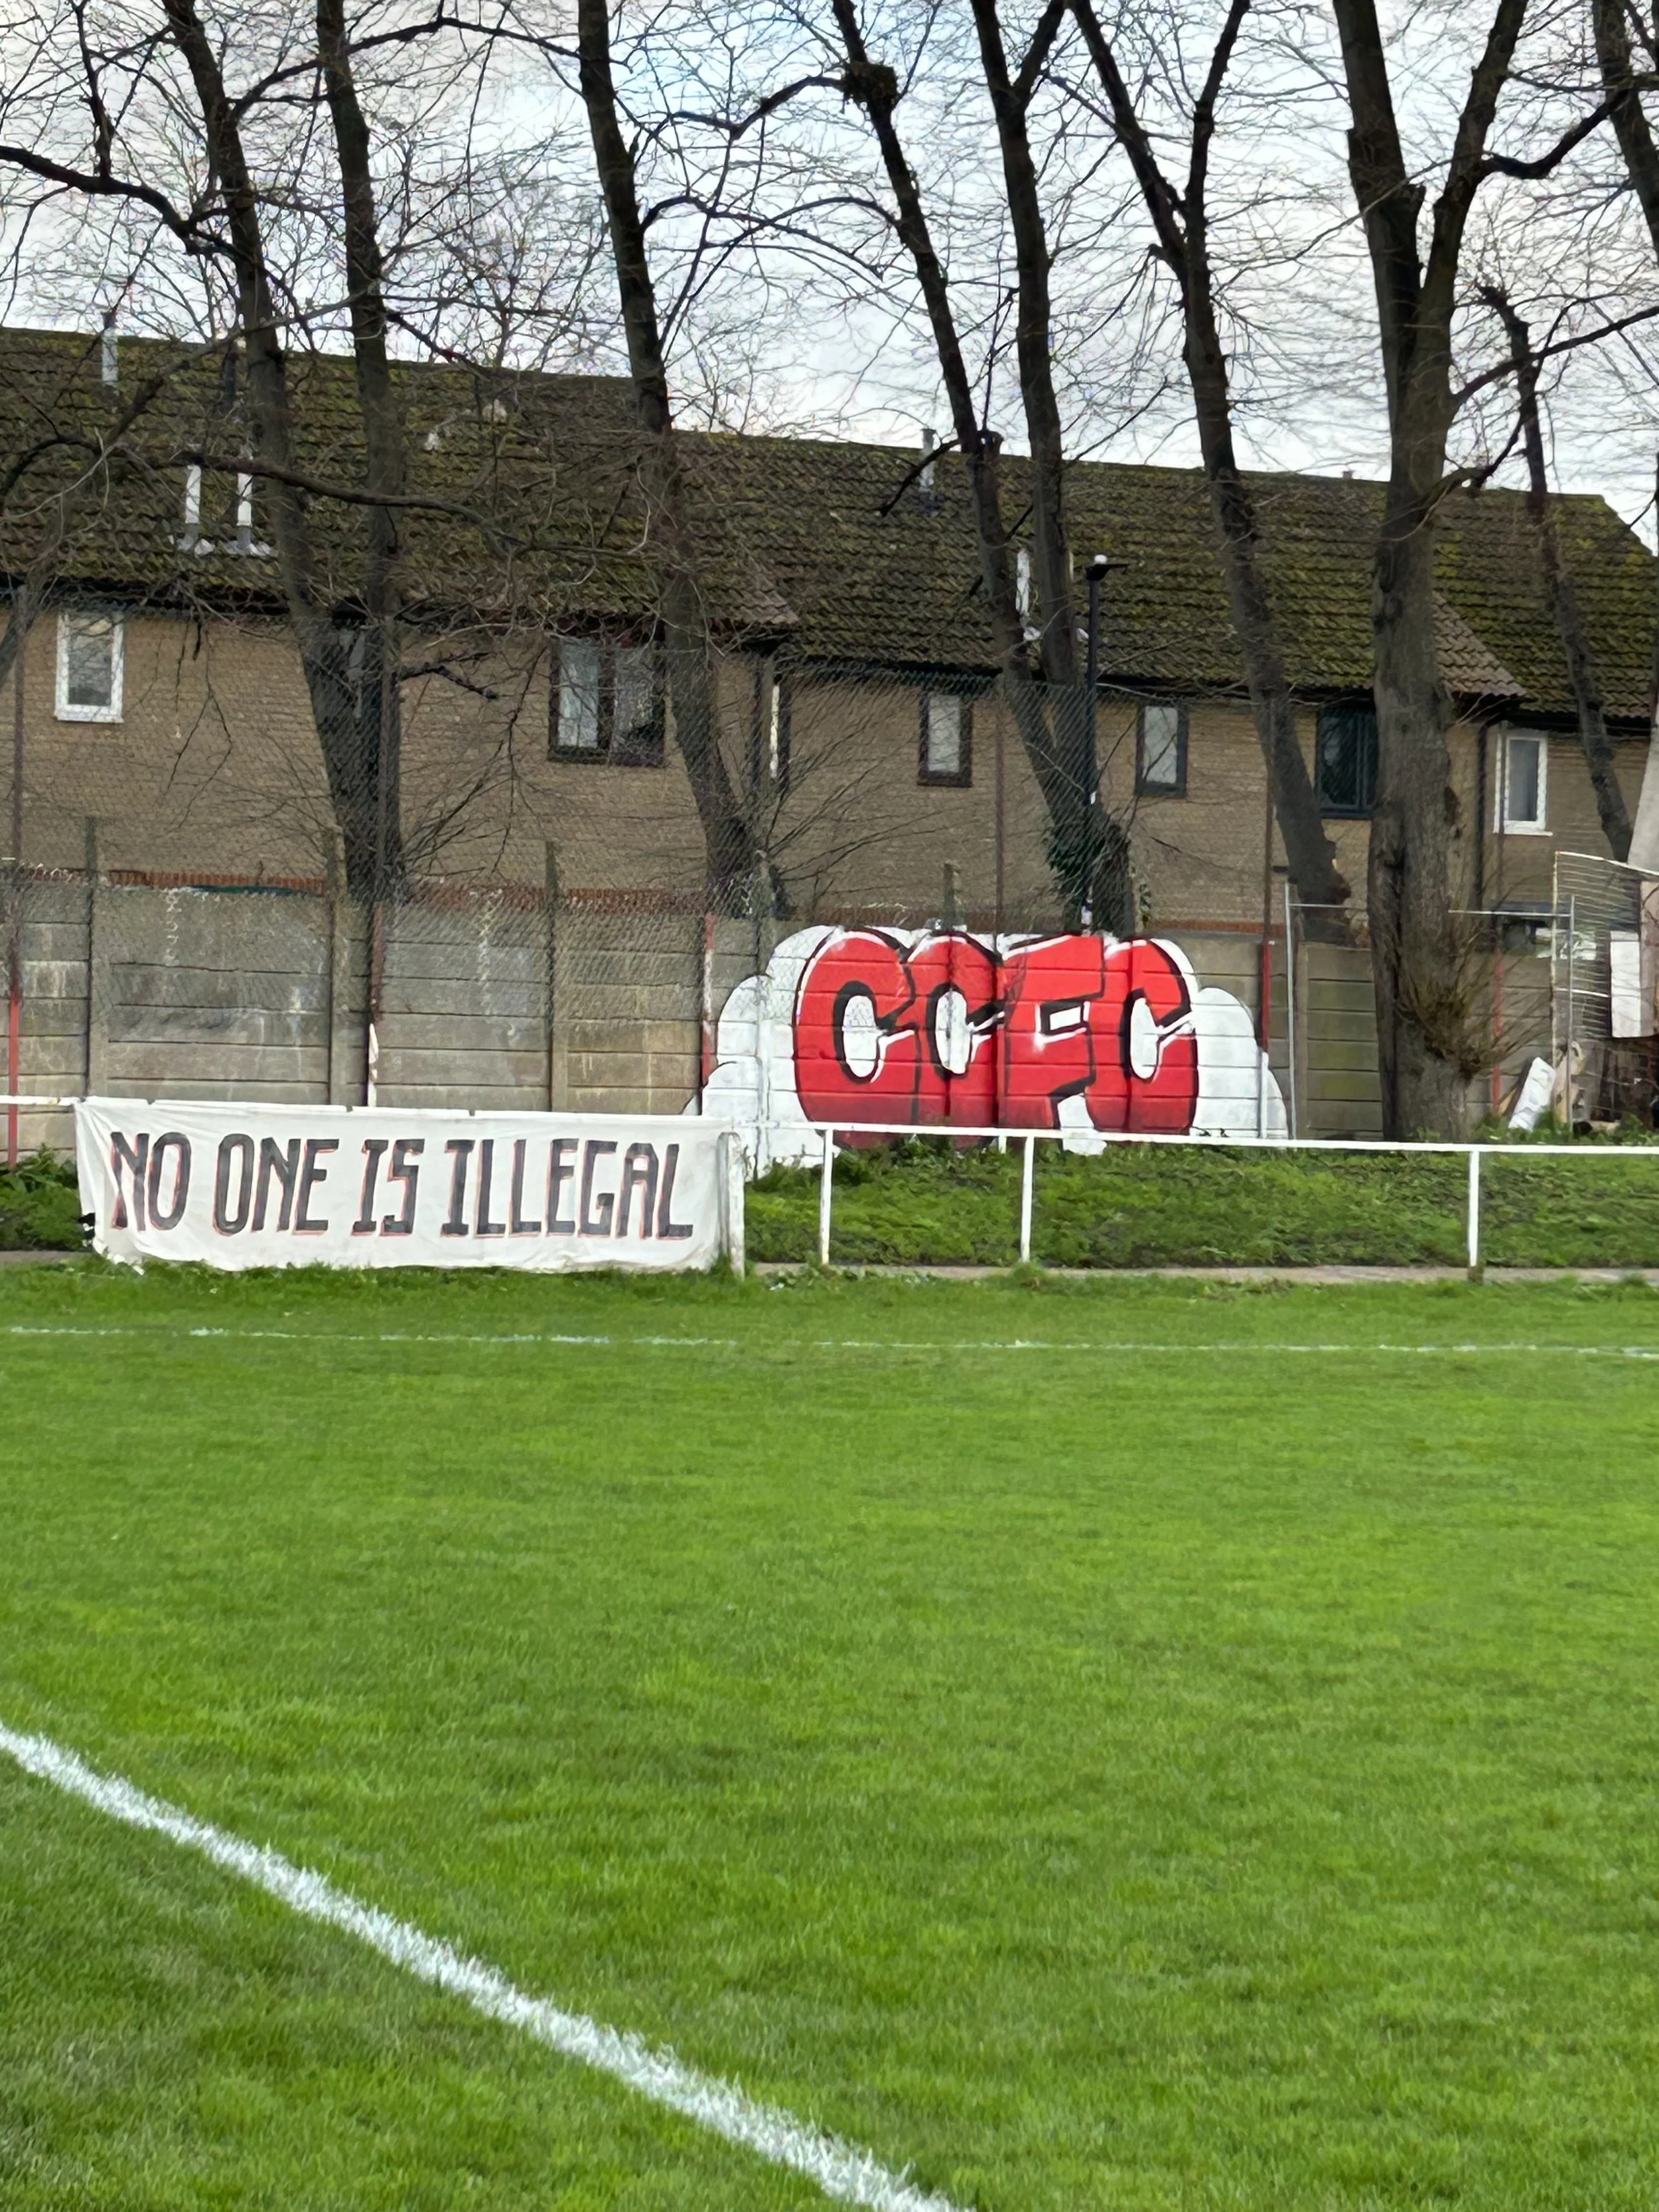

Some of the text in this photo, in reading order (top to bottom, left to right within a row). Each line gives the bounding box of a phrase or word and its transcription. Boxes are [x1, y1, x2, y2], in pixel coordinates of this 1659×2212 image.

[792, 928, 1200, 1149] CCFC
[110, 1131, 693, 1240] NO ONE IS ILLEGAL
